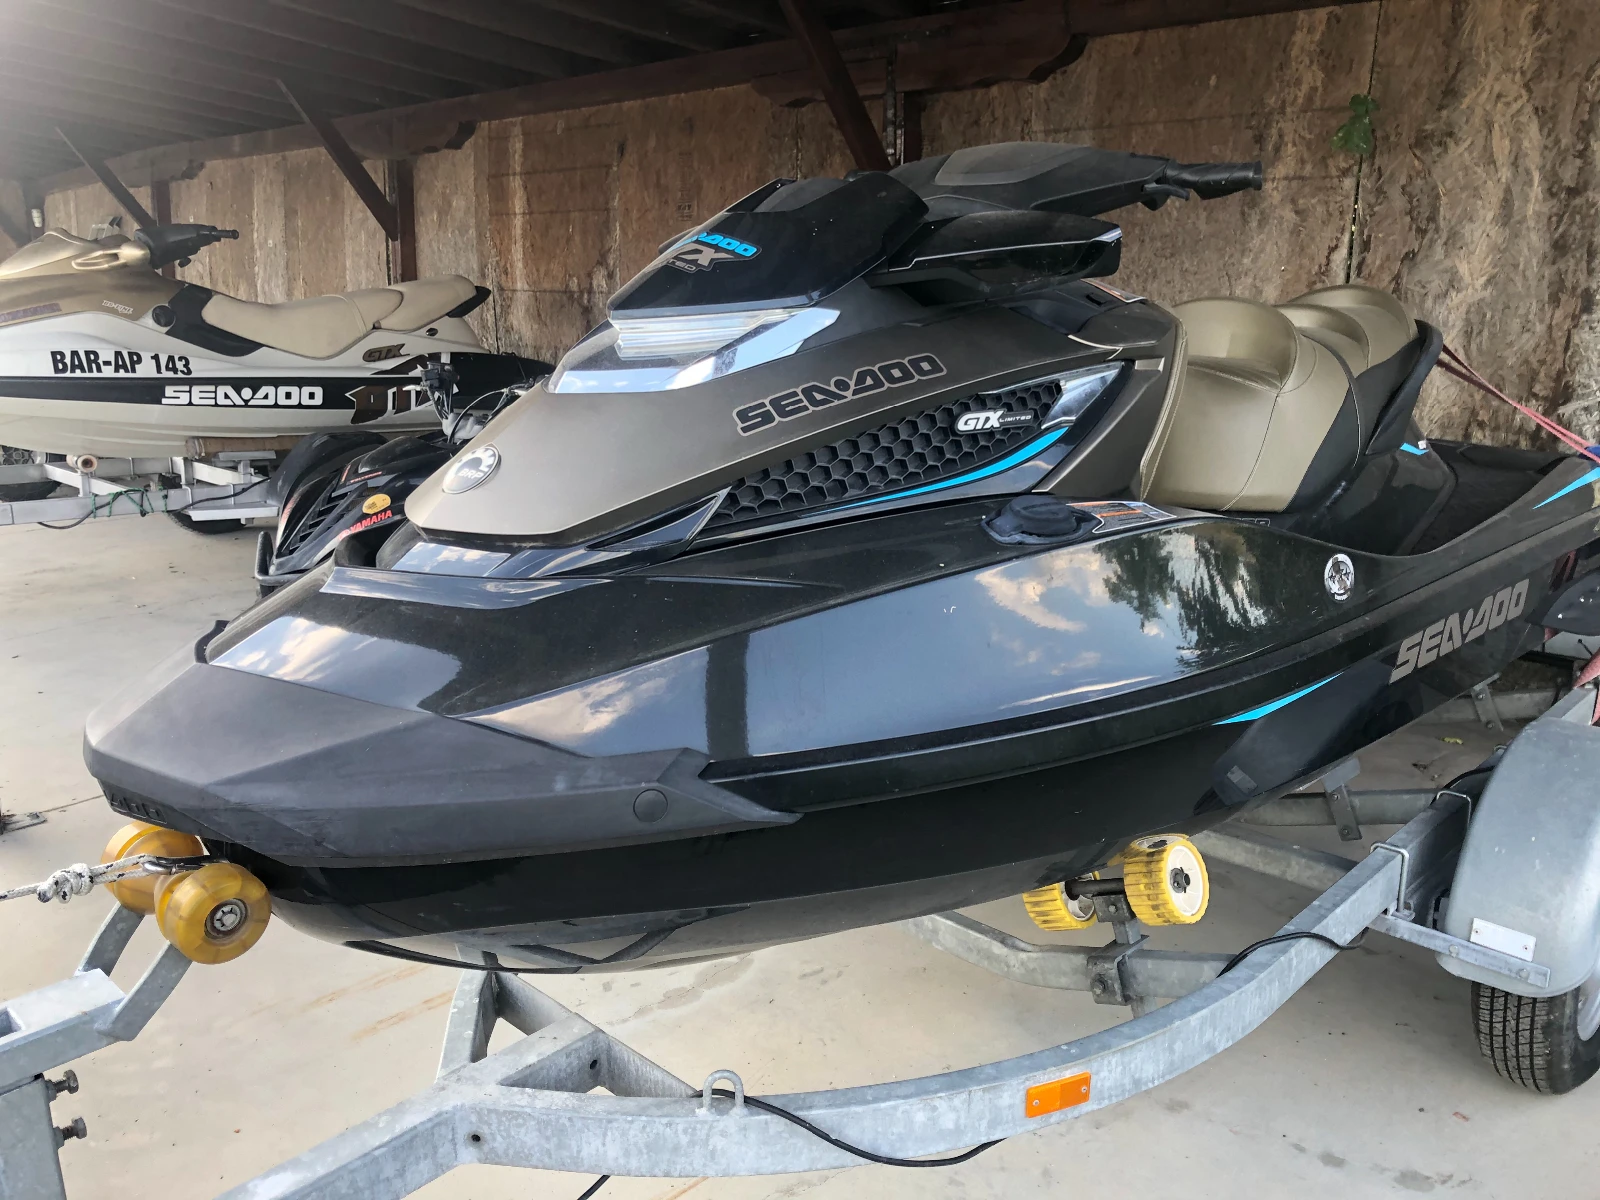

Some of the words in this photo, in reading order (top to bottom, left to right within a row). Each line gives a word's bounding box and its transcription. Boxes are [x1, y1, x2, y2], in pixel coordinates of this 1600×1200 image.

[50, 350, 143, 374] BAR-AP
[150, 353, 192, 376] 143
[362, 343, 410, 362] GTX
[957, 410, 1004, 431] GTX
[458, 468, 484, 479] BRP
[349, 510, 392, 533] YAMAHA
